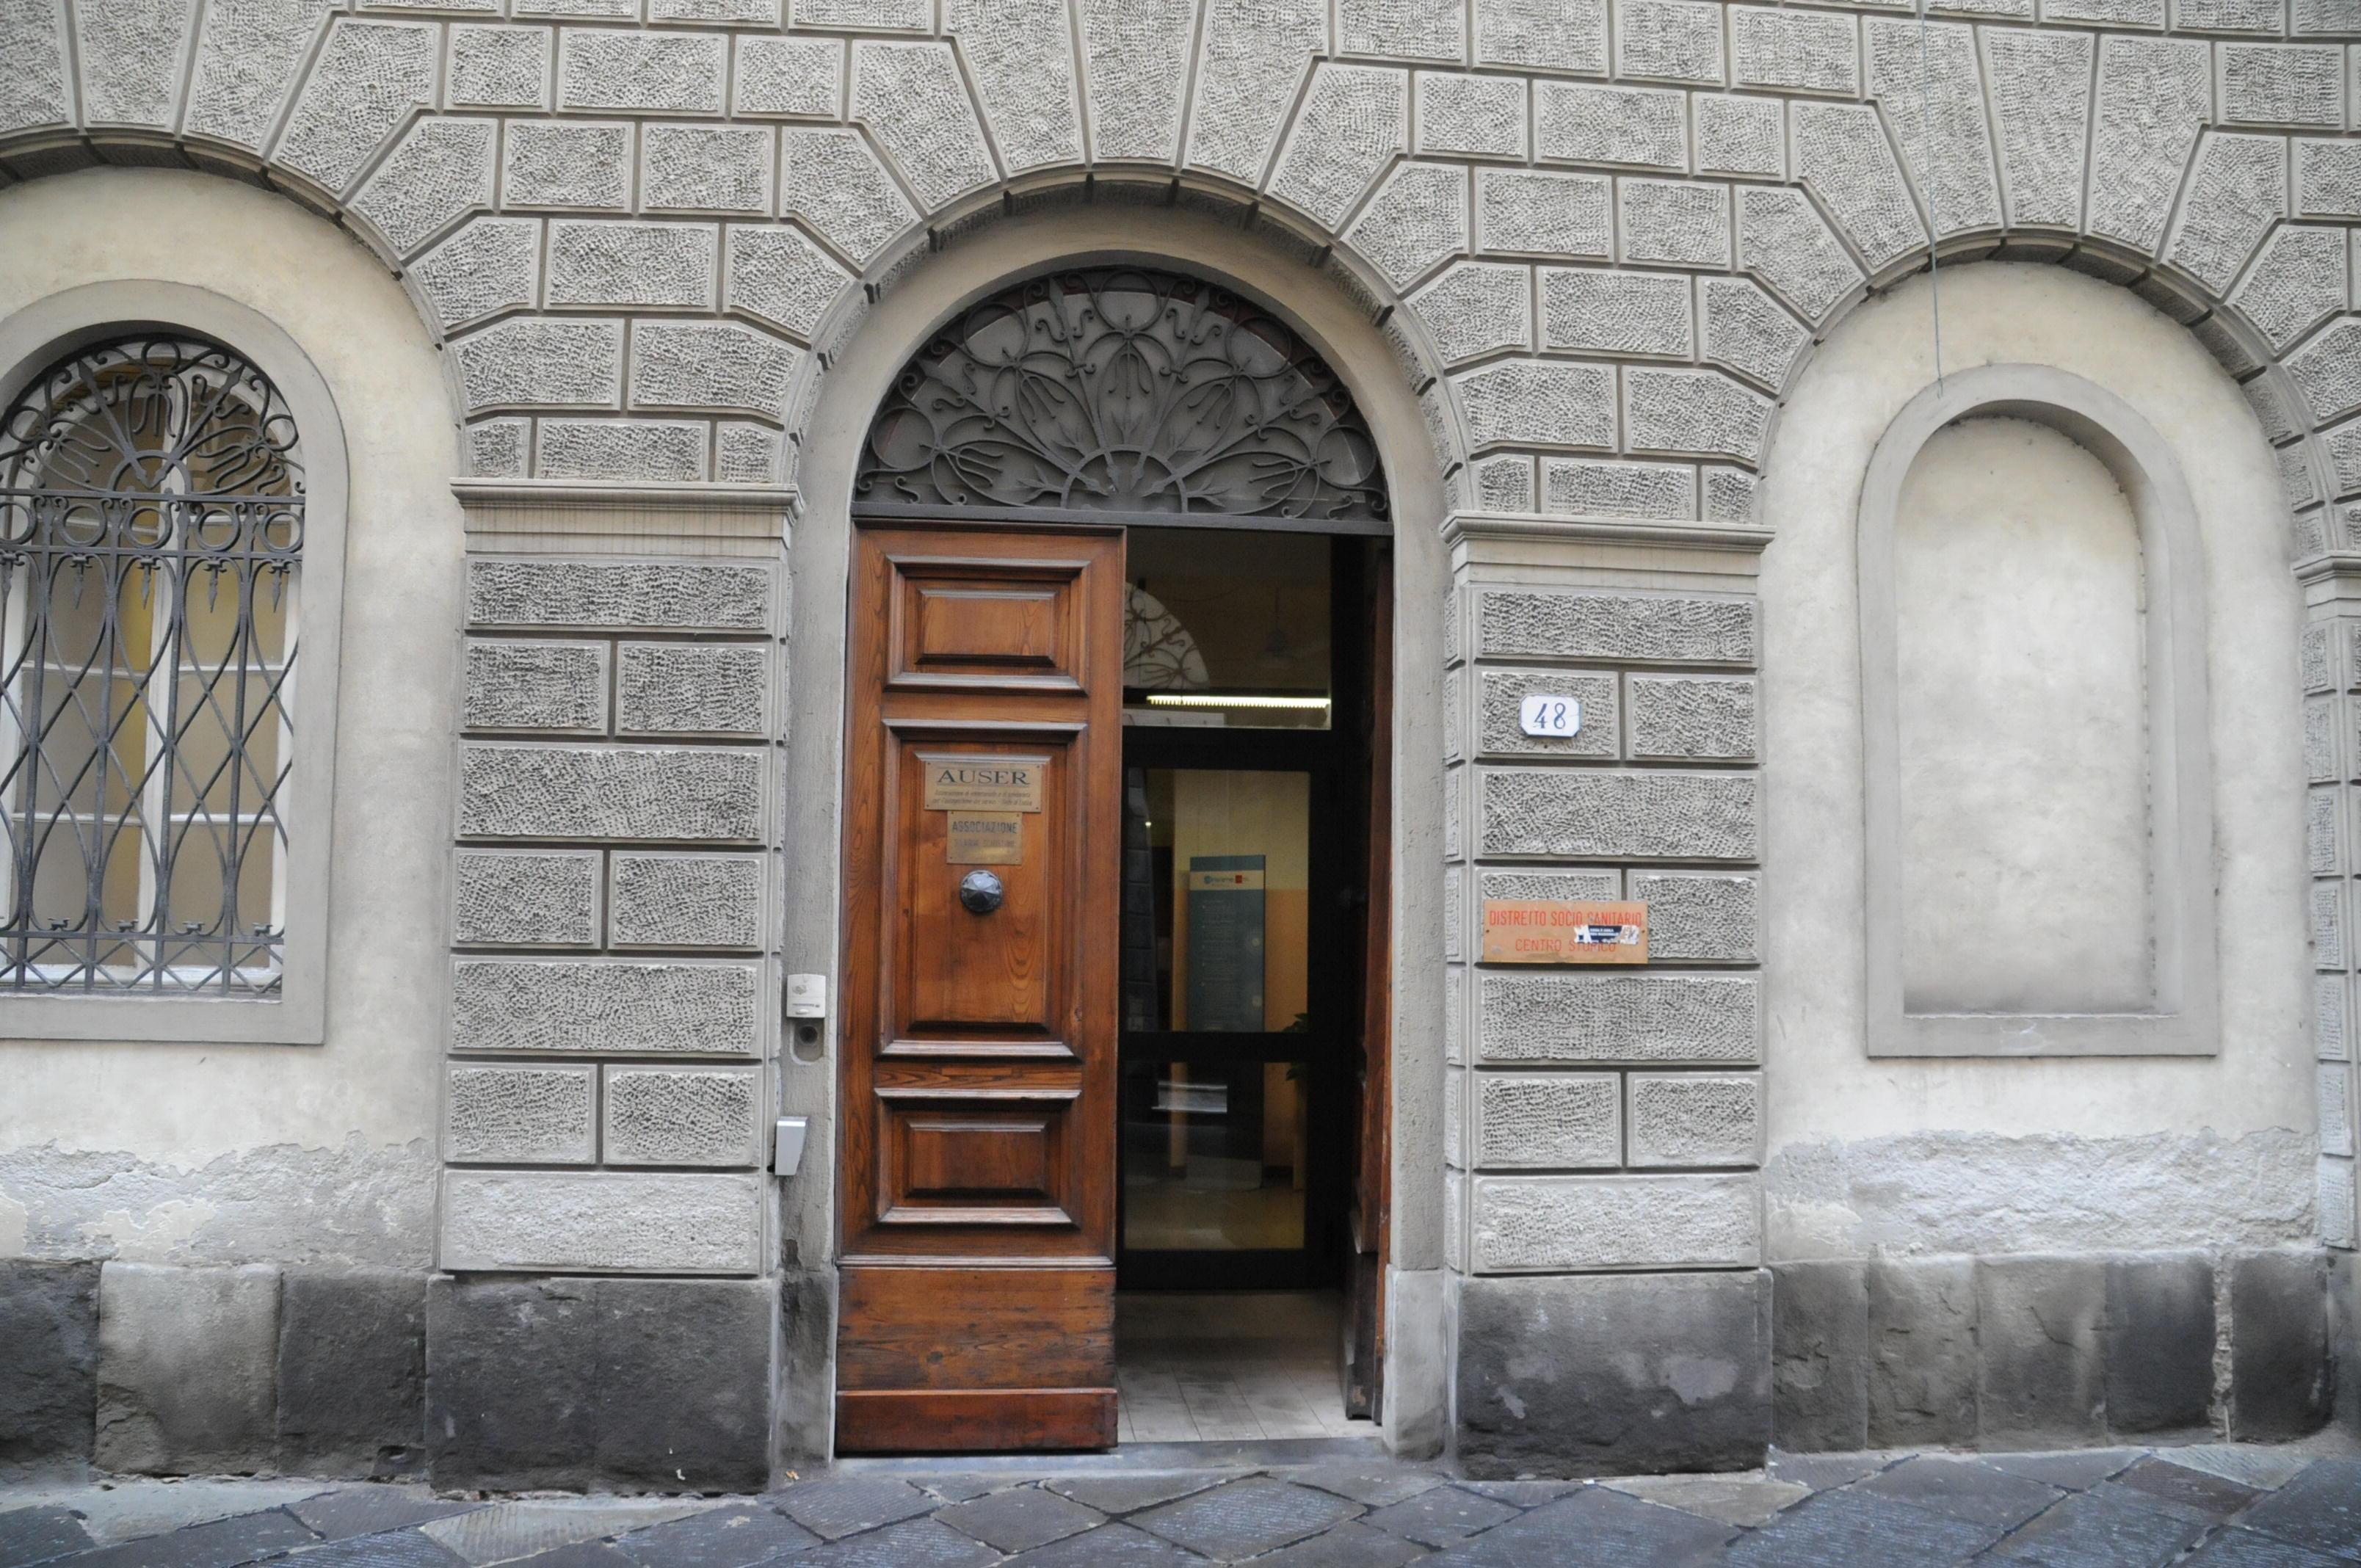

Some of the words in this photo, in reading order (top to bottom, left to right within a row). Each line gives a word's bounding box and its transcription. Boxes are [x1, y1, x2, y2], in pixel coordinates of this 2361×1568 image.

[1532, 702, 1567, 730] 48
[937, 769, 1031, 785] AUSER
[951, 821, 1018, 834] ASSOCIAZIONE
[1489, 910, 1546, 926] DISTRETTO
[1551, 911, 1583, 926] SOCIO
[1586, 912, 1642, 926] SANITARIO
[1515, 939, 1562, 952] CENTRO
